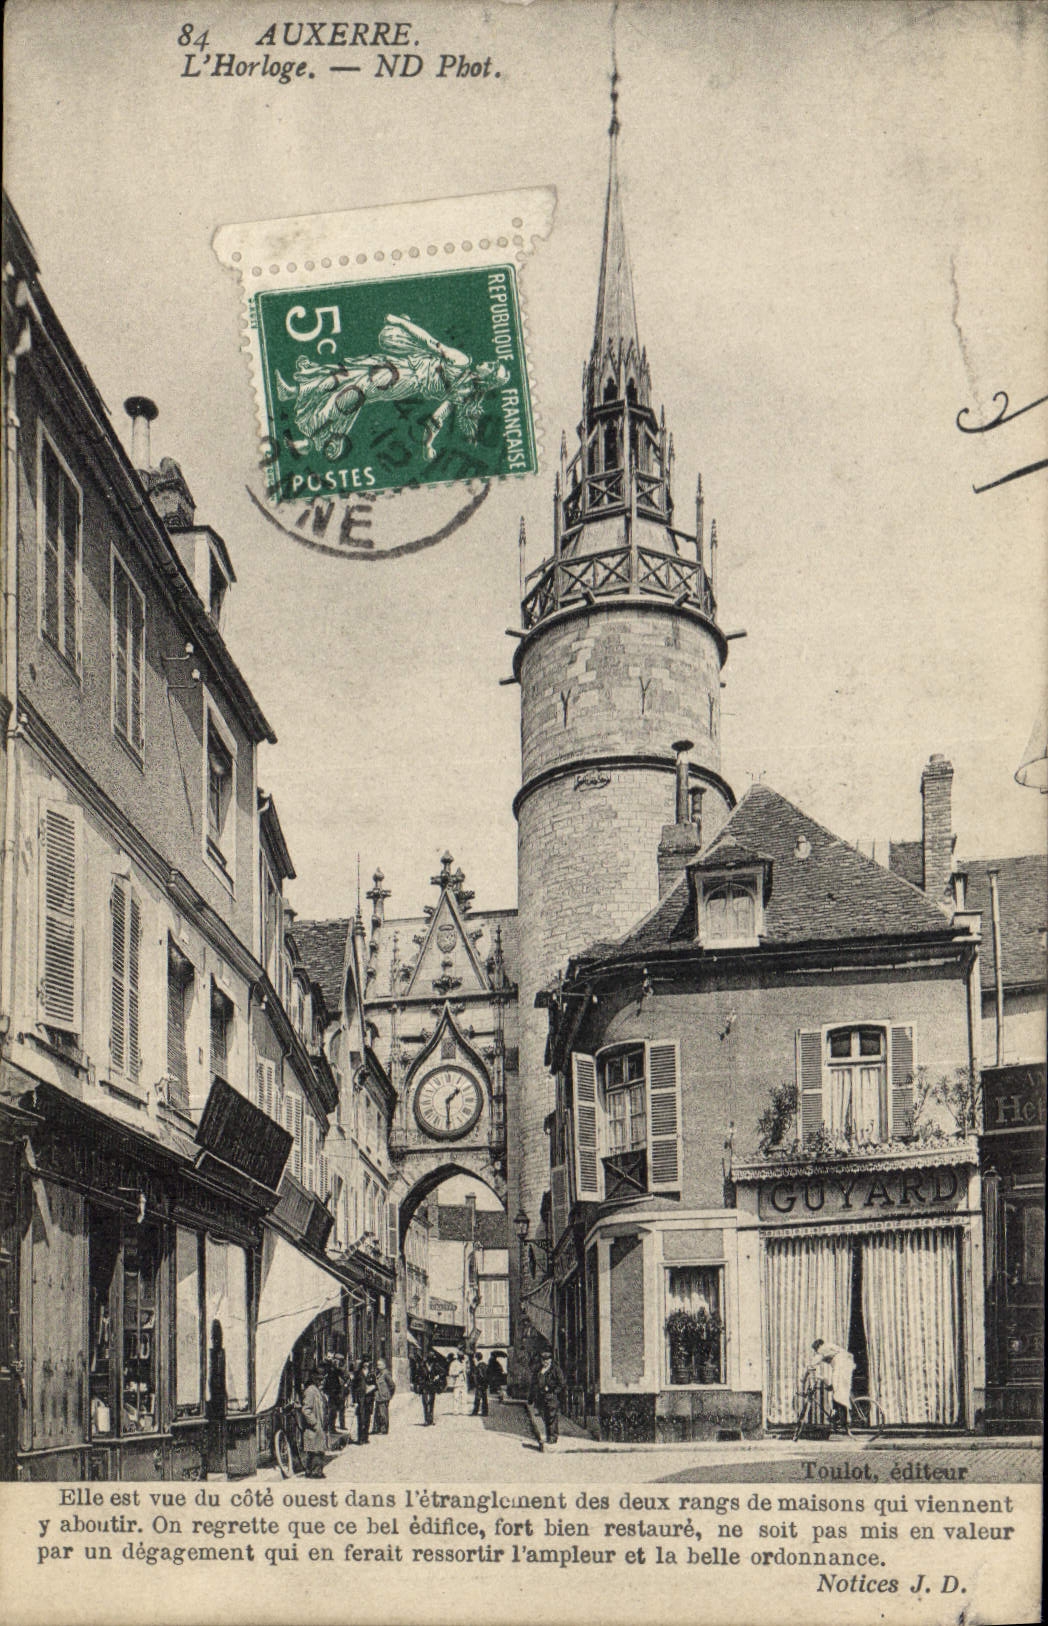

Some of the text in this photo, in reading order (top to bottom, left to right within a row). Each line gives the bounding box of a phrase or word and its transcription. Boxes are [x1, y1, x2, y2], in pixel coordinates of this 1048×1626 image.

[487, 273, 514, 362] REPUBLIQUE
[292, 466, 376, 493] POSTES
[769, 1168, 959, 1213] GUYARD
